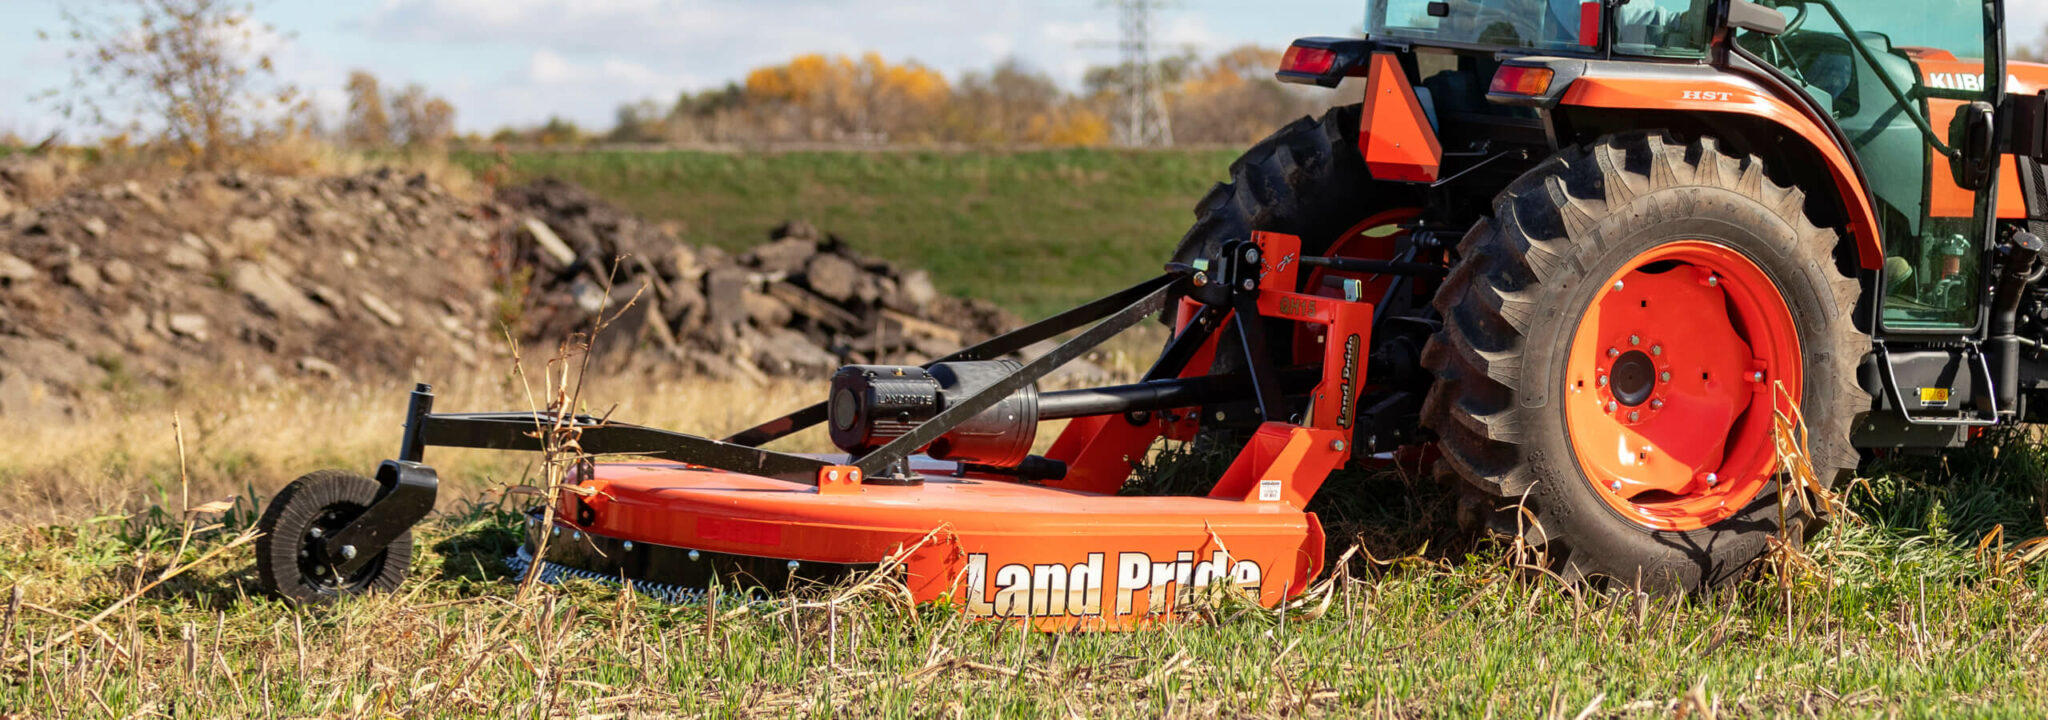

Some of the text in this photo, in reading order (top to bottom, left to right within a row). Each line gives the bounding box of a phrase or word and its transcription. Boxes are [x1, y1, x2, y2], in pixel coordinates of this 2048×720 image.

[1682, 90, 1733, 101] HST
[1560, 187, 1698, 284] TITAN
[1280, 296, 1316, 317] QH15
[1336, 383, 1349, 426] Land
[966, 550, 1262, 618] Land Pride
